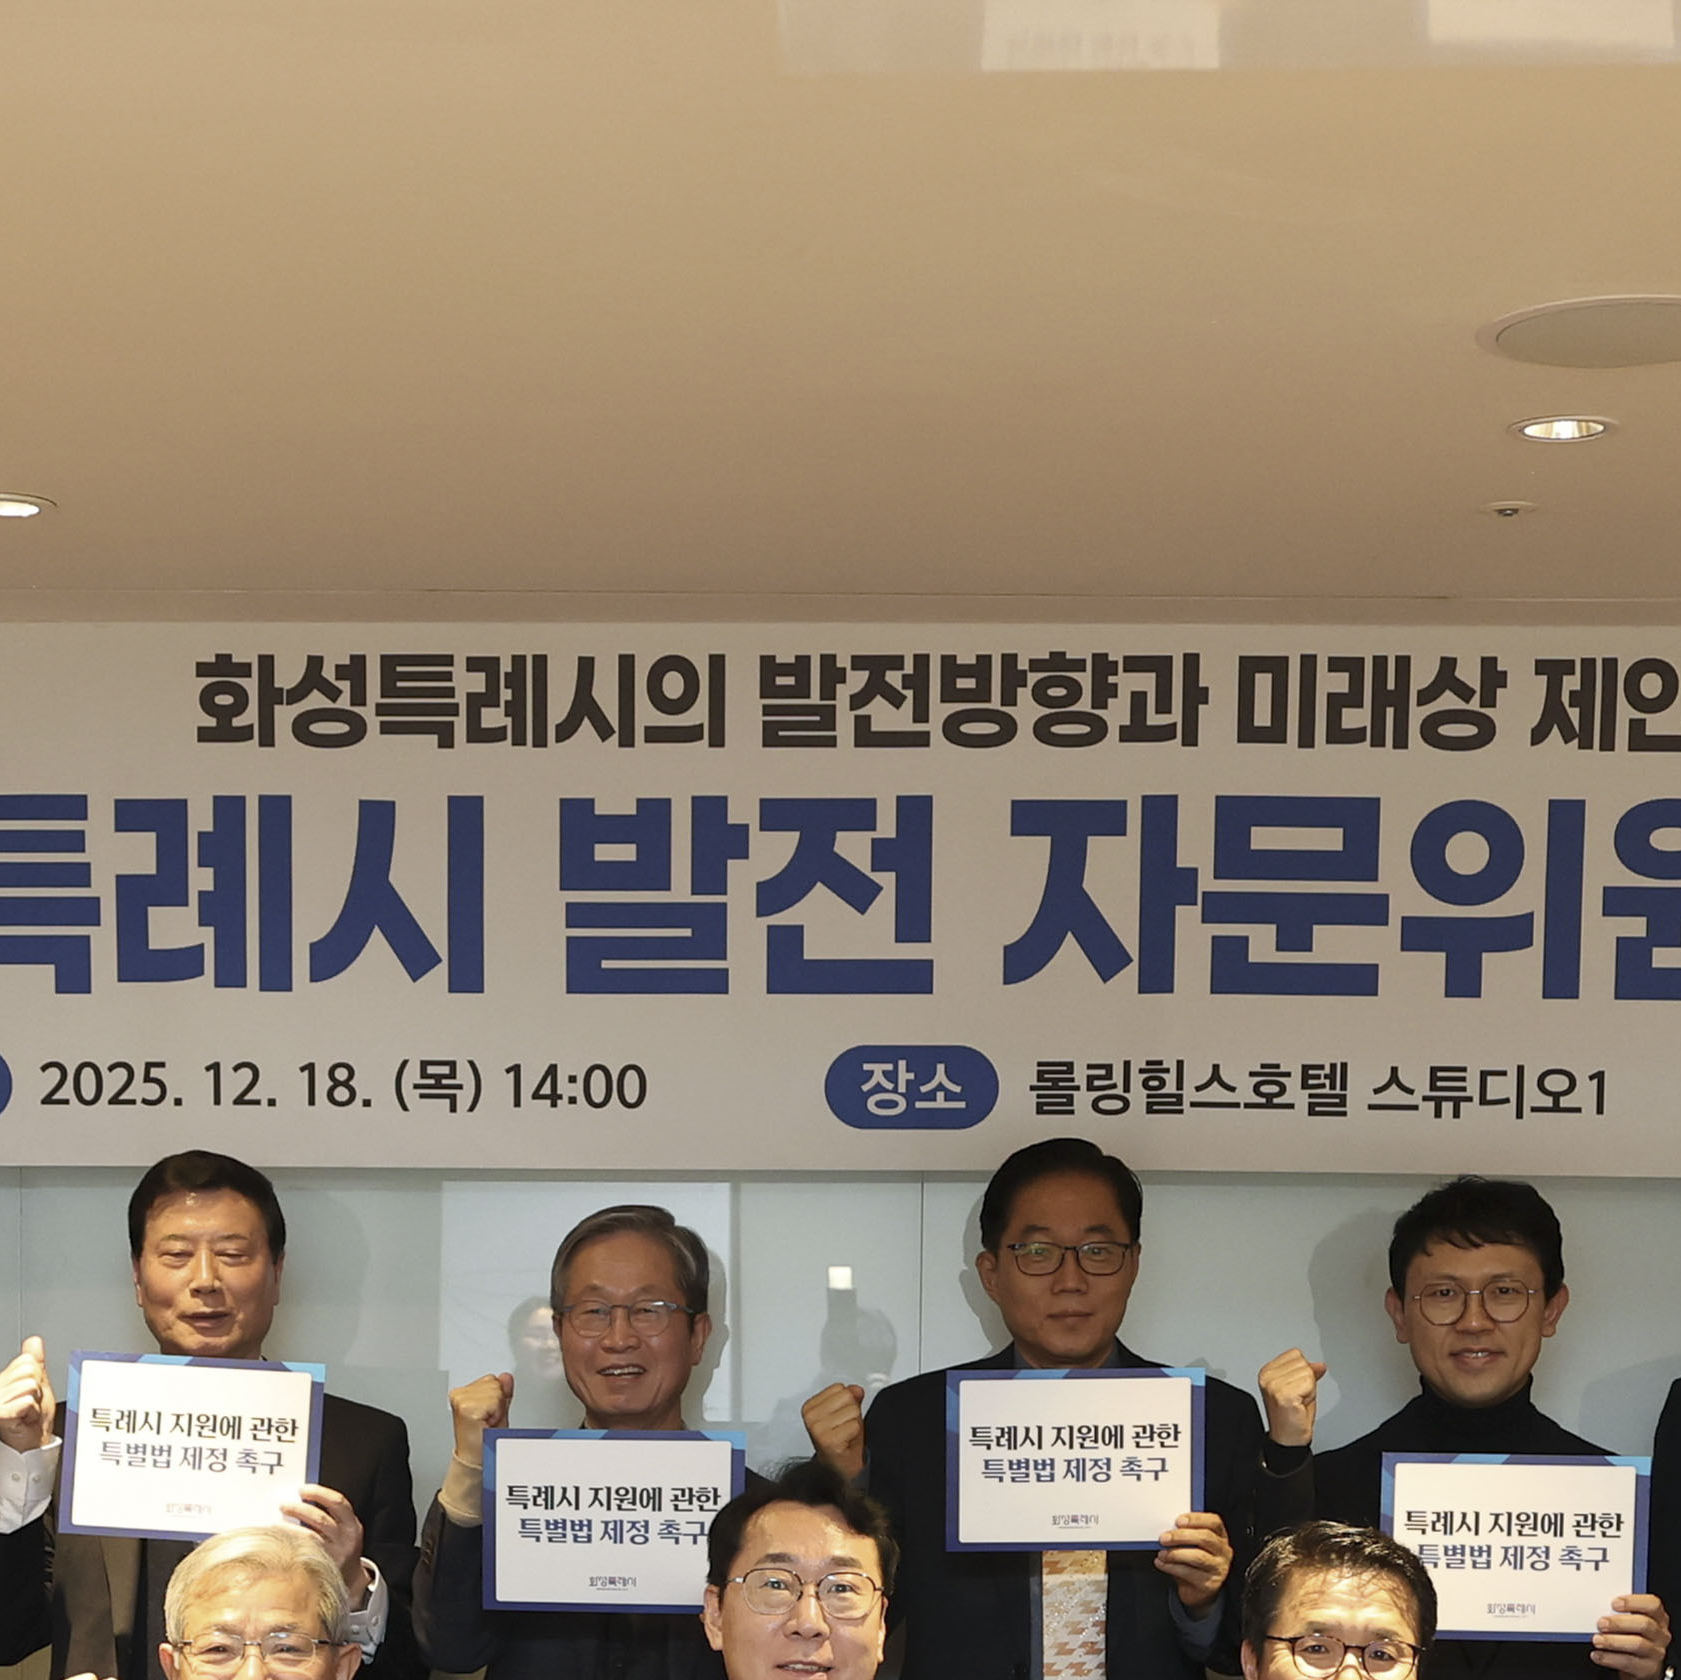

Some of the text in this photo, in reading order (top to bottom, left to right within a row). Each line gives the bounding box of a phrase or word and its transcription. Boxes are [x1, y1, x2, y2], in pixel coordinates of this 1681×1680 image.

[196, 653, 725, 749] 화성특례시의
[760, 651, 1209, 748] 발전방향과
[1237, 654, 1507, 751] 미래상
[559, 795, 934, 994] 발전
[40, 1061, 182, 1106] 2025.
[205, 1062, 276, 1107] 12.
[299, 1062, 371, 1107] 18.
[395, 1059, 481, 1113] (목)
[505, 1064, 646, 1109] 14:00
[861, 1060, 1605, 1119] 장소 롤링힐스호텔 스튜디오1
[91, 1408, 298, 1443] 특례시 지원에 관한
[969, 1424, 1181, 1450] 특례시 지원에 관한
[101, 1442, 283, 1475] 특별법 제정 촉구
[982, 1457, 1168, 1483] 특별법 제정 촉구
[506, 1485, 721, 1512] 특례시 지원에 관한
[519, 1518, 708, 1545] 특별법 제정 촉구
[1405, 1511, 1624, 1538] 특례시 지원에 관한
[1416, 1543, 1609, 1571] 특별법 제정 촉구
